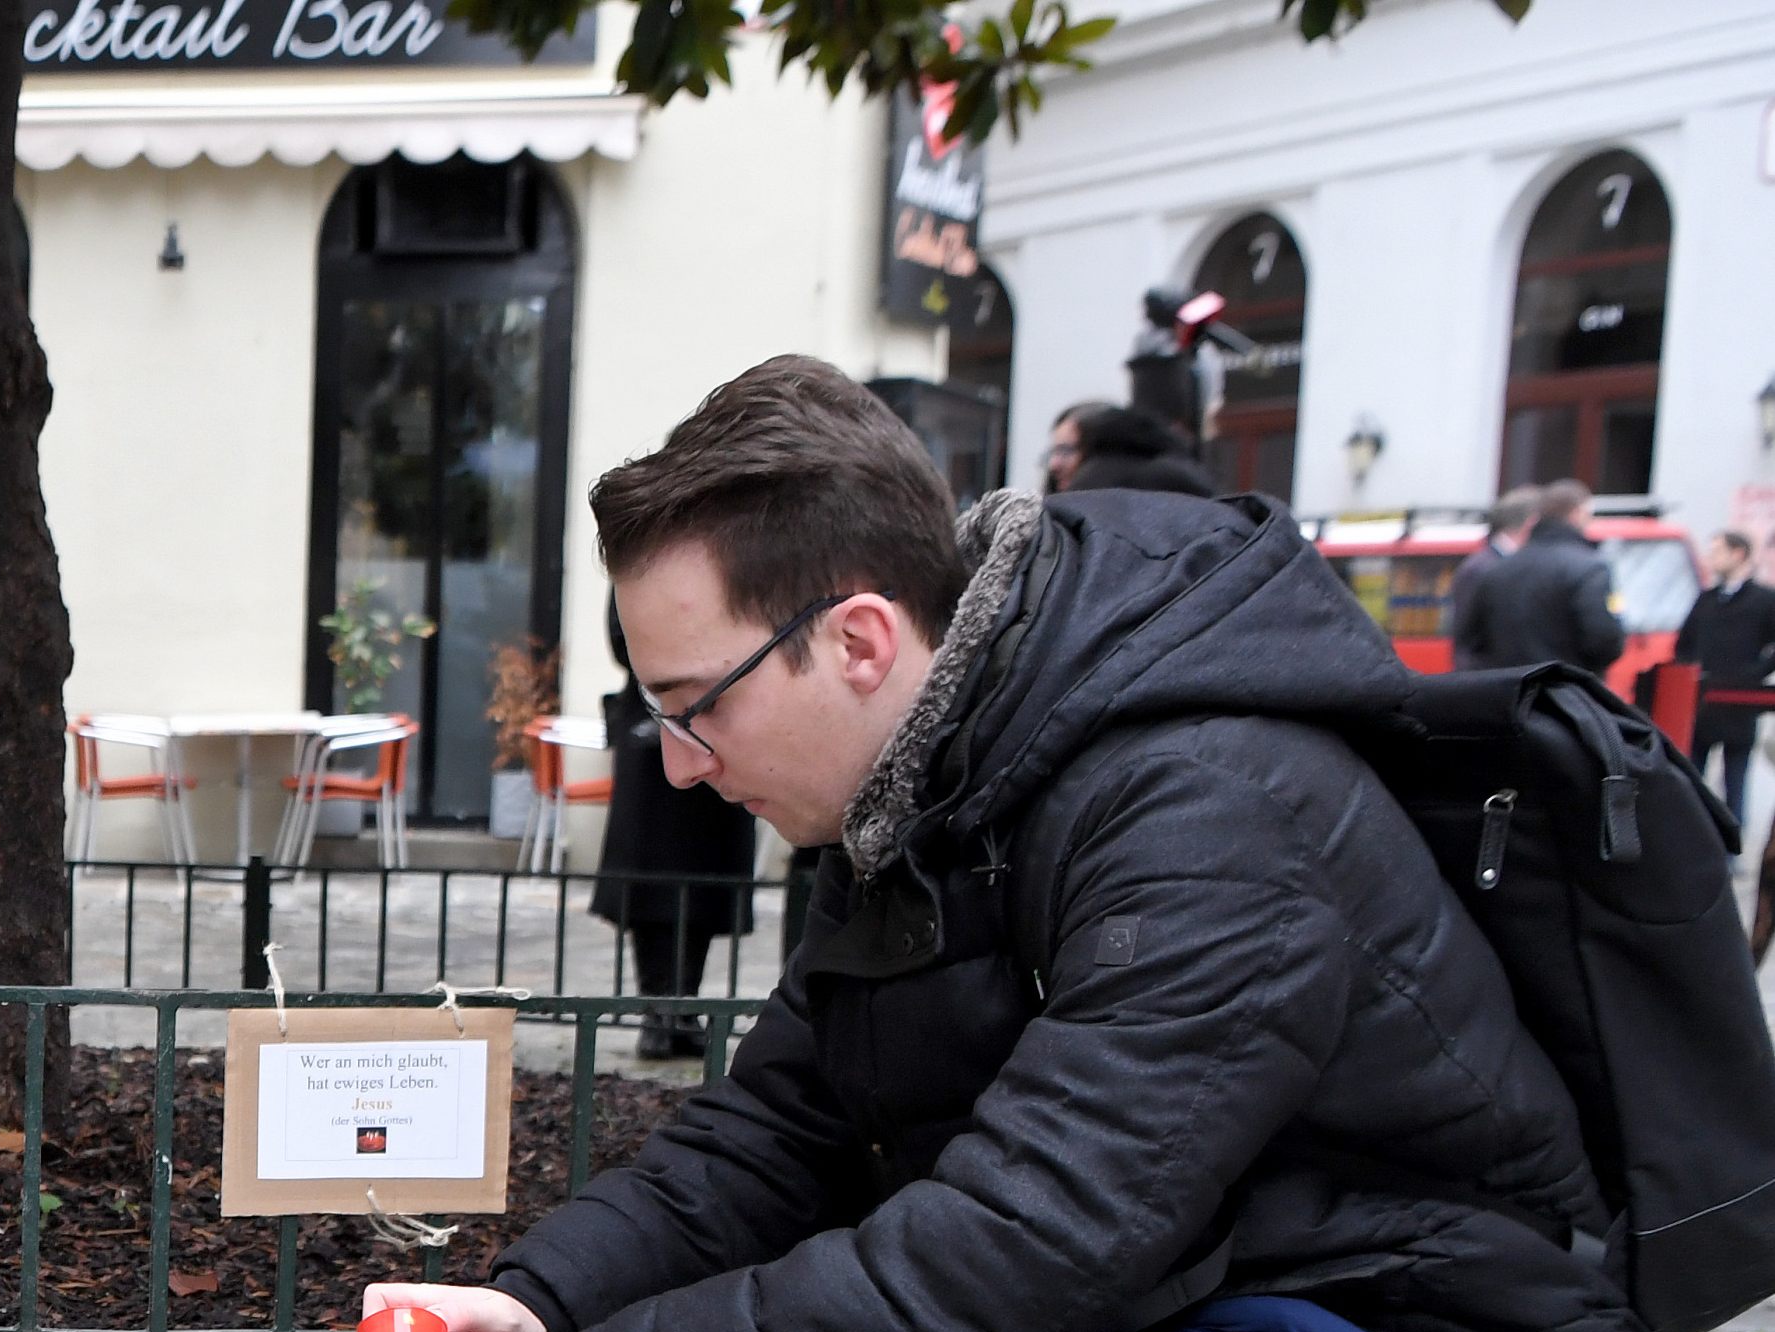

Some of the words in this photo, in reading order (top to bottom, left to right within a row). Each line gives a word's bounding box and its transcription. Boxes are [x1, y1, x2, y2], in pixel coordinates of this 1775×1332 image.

[23, 0, 251, 61] cktail
[272, 0, 445, 59] Bar
[300, 1055, 331, 1068] Wer
[335, 1058, 352, 1068] an
[357, 1054, 393, 1068] mich
[398, 1053, 448, 1071] glaubt,
[307, 1076, 329, 1090] hat
[334, 1075, 384, 1092] ewiges
[389, 1075, 439, 1089] Leben.
[351, 1097, 393, 1111] Jesus
[352, 1116, 376, 1126] Sohn
[378, 1115, 413, 1126] Gottes)
